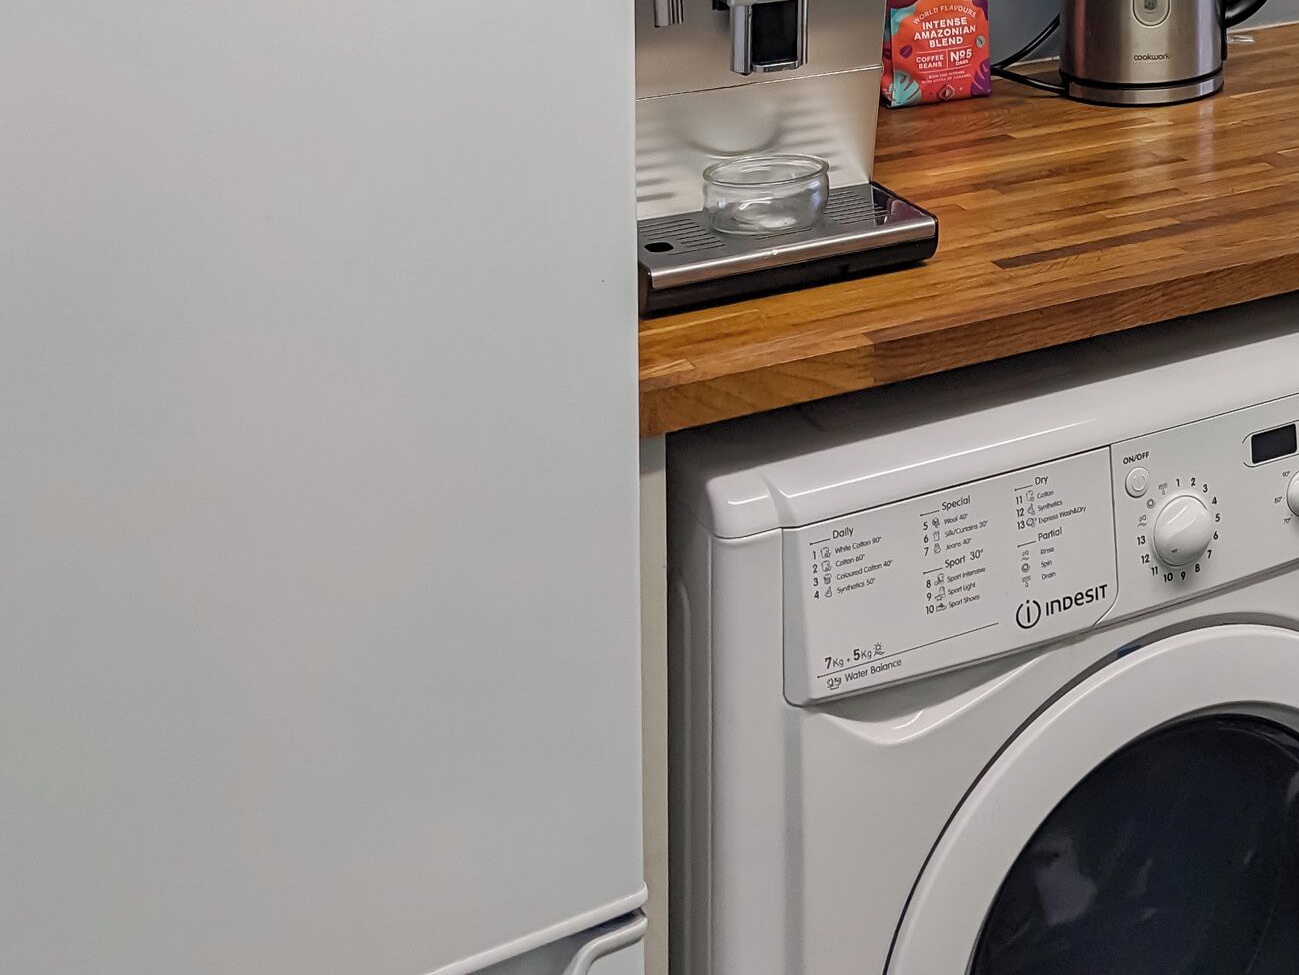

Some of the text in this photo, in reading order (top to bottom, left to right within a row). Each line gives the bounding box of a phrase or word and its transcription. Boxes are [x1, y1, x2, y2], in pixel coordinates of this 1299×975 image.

[912, 5, 977, 26] WORLD FLAVOURS
[922, 17, 968, 30] INTENSE
[914, 25, 976, 40] AMAZONIAN
[929, 37, 964, 48] BLEND
[916, 55, 944, 63] COFFEE
[918, 61, 942, 69] BEANS
[1122, 451, 1149, 464] ON/OFF
[1035, 476, 1048, 486] Dry
[1176, 478, 1180, 487] 1
[1191, 477, 1196, 487] 2
[1203, 484, 1208, 493] 3
[1015, 490, 1054, 505] 11 Cotton
[1212, 497, 1217, 505] 4
[941, 495, 971, 512] Special
[1016, 499, 1063, 517] 12 Synthetics
[923, 515, 958, 531] 5 Wool
[1215, 514, 1220, 522] 5
[1017, 520, 1025, 530] 13
[832, 527, 854, 539] Daily
[1038, 527, 1063, 542] Partial
[1213, 531, 1218, 540] 6
[923, 535, 929, 544] 6
[1137, 536, 1146, 545] 13
[812, 540, 872, 560] 1 White Cotton
[923, 541, 962, 556] 7 Jeans
[1141, 554, 1150, 564] 12
[1207, 550, 1212, 559] 7
[812, 557, 855, 573] 2 Cotton
[944, 555, 966, 569] Sport
[1151, 566, 1158, 576] 11
[1195, 564, 1200, 572] 8
[813, 563, 883, 587] 3 Coloured Cotton
[1164, 573, 1173, 583] 10
[1180, 571, 1186, 580] 9
[926, 579, 932, 588] 8
[814, 582, 865, 599] 4 Synthetics
[926, 582, 976, 602] 9 Sport Light
[926, 594, 980, 614] 10 Sport Shoes
[1045, 584, 1108, 617] INDESIT
[845, 659, 902, 682] Water Balance
